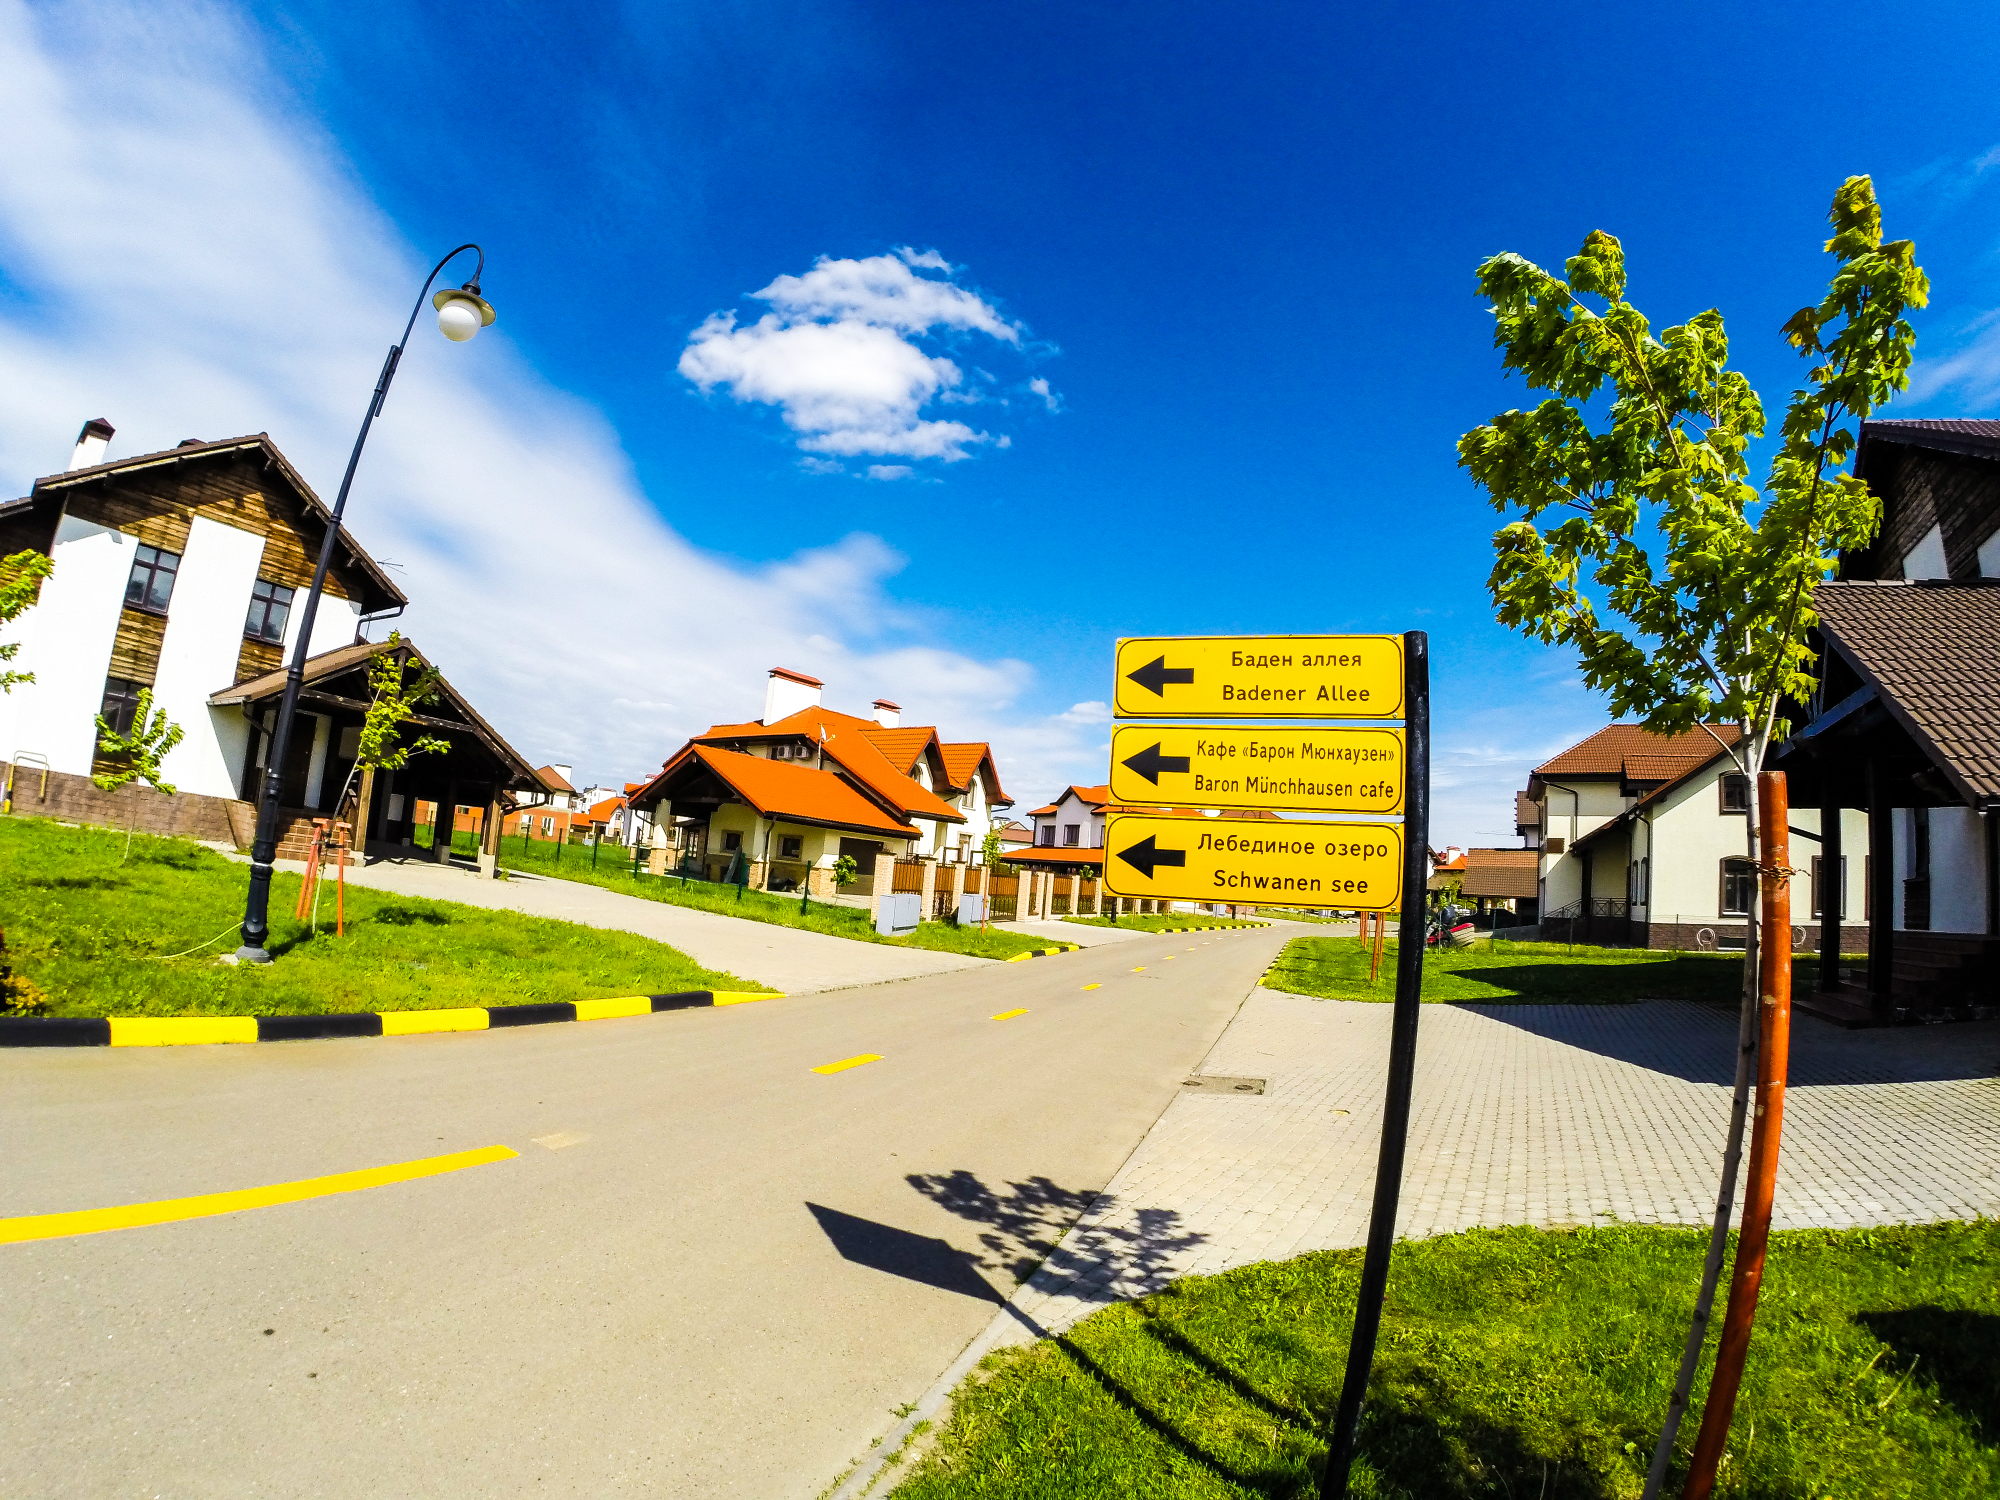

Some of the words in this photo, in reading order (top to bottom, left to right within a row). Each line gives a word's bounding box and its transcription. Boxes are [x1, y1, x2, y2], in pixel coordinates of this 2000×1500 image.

[1232, 651, 1292, 668] Баден
[1302, 655, 1361, 666] аллея
[1223, 685, 1306, 701] Badener
[1317, 685, 1369, 701] Allee
[1197, 740, 1236, 760] Кафе
[1243, 742, 1294, 762] «Барон
[1302, 743, 1394, 765] Мюнхаузен»
[1195, 775, 1238, 792] Baron
[1246, 776, 1352, 796] Münchhausen
[1360, 781, 1393, 798] cafe
[1198, 834, 1314, 854] Лебединое
[1325, 843, 1387, 861] озеро
[1213, 870, 1320, 891] Schwanen
[1332, 880, 1368, 893] see
